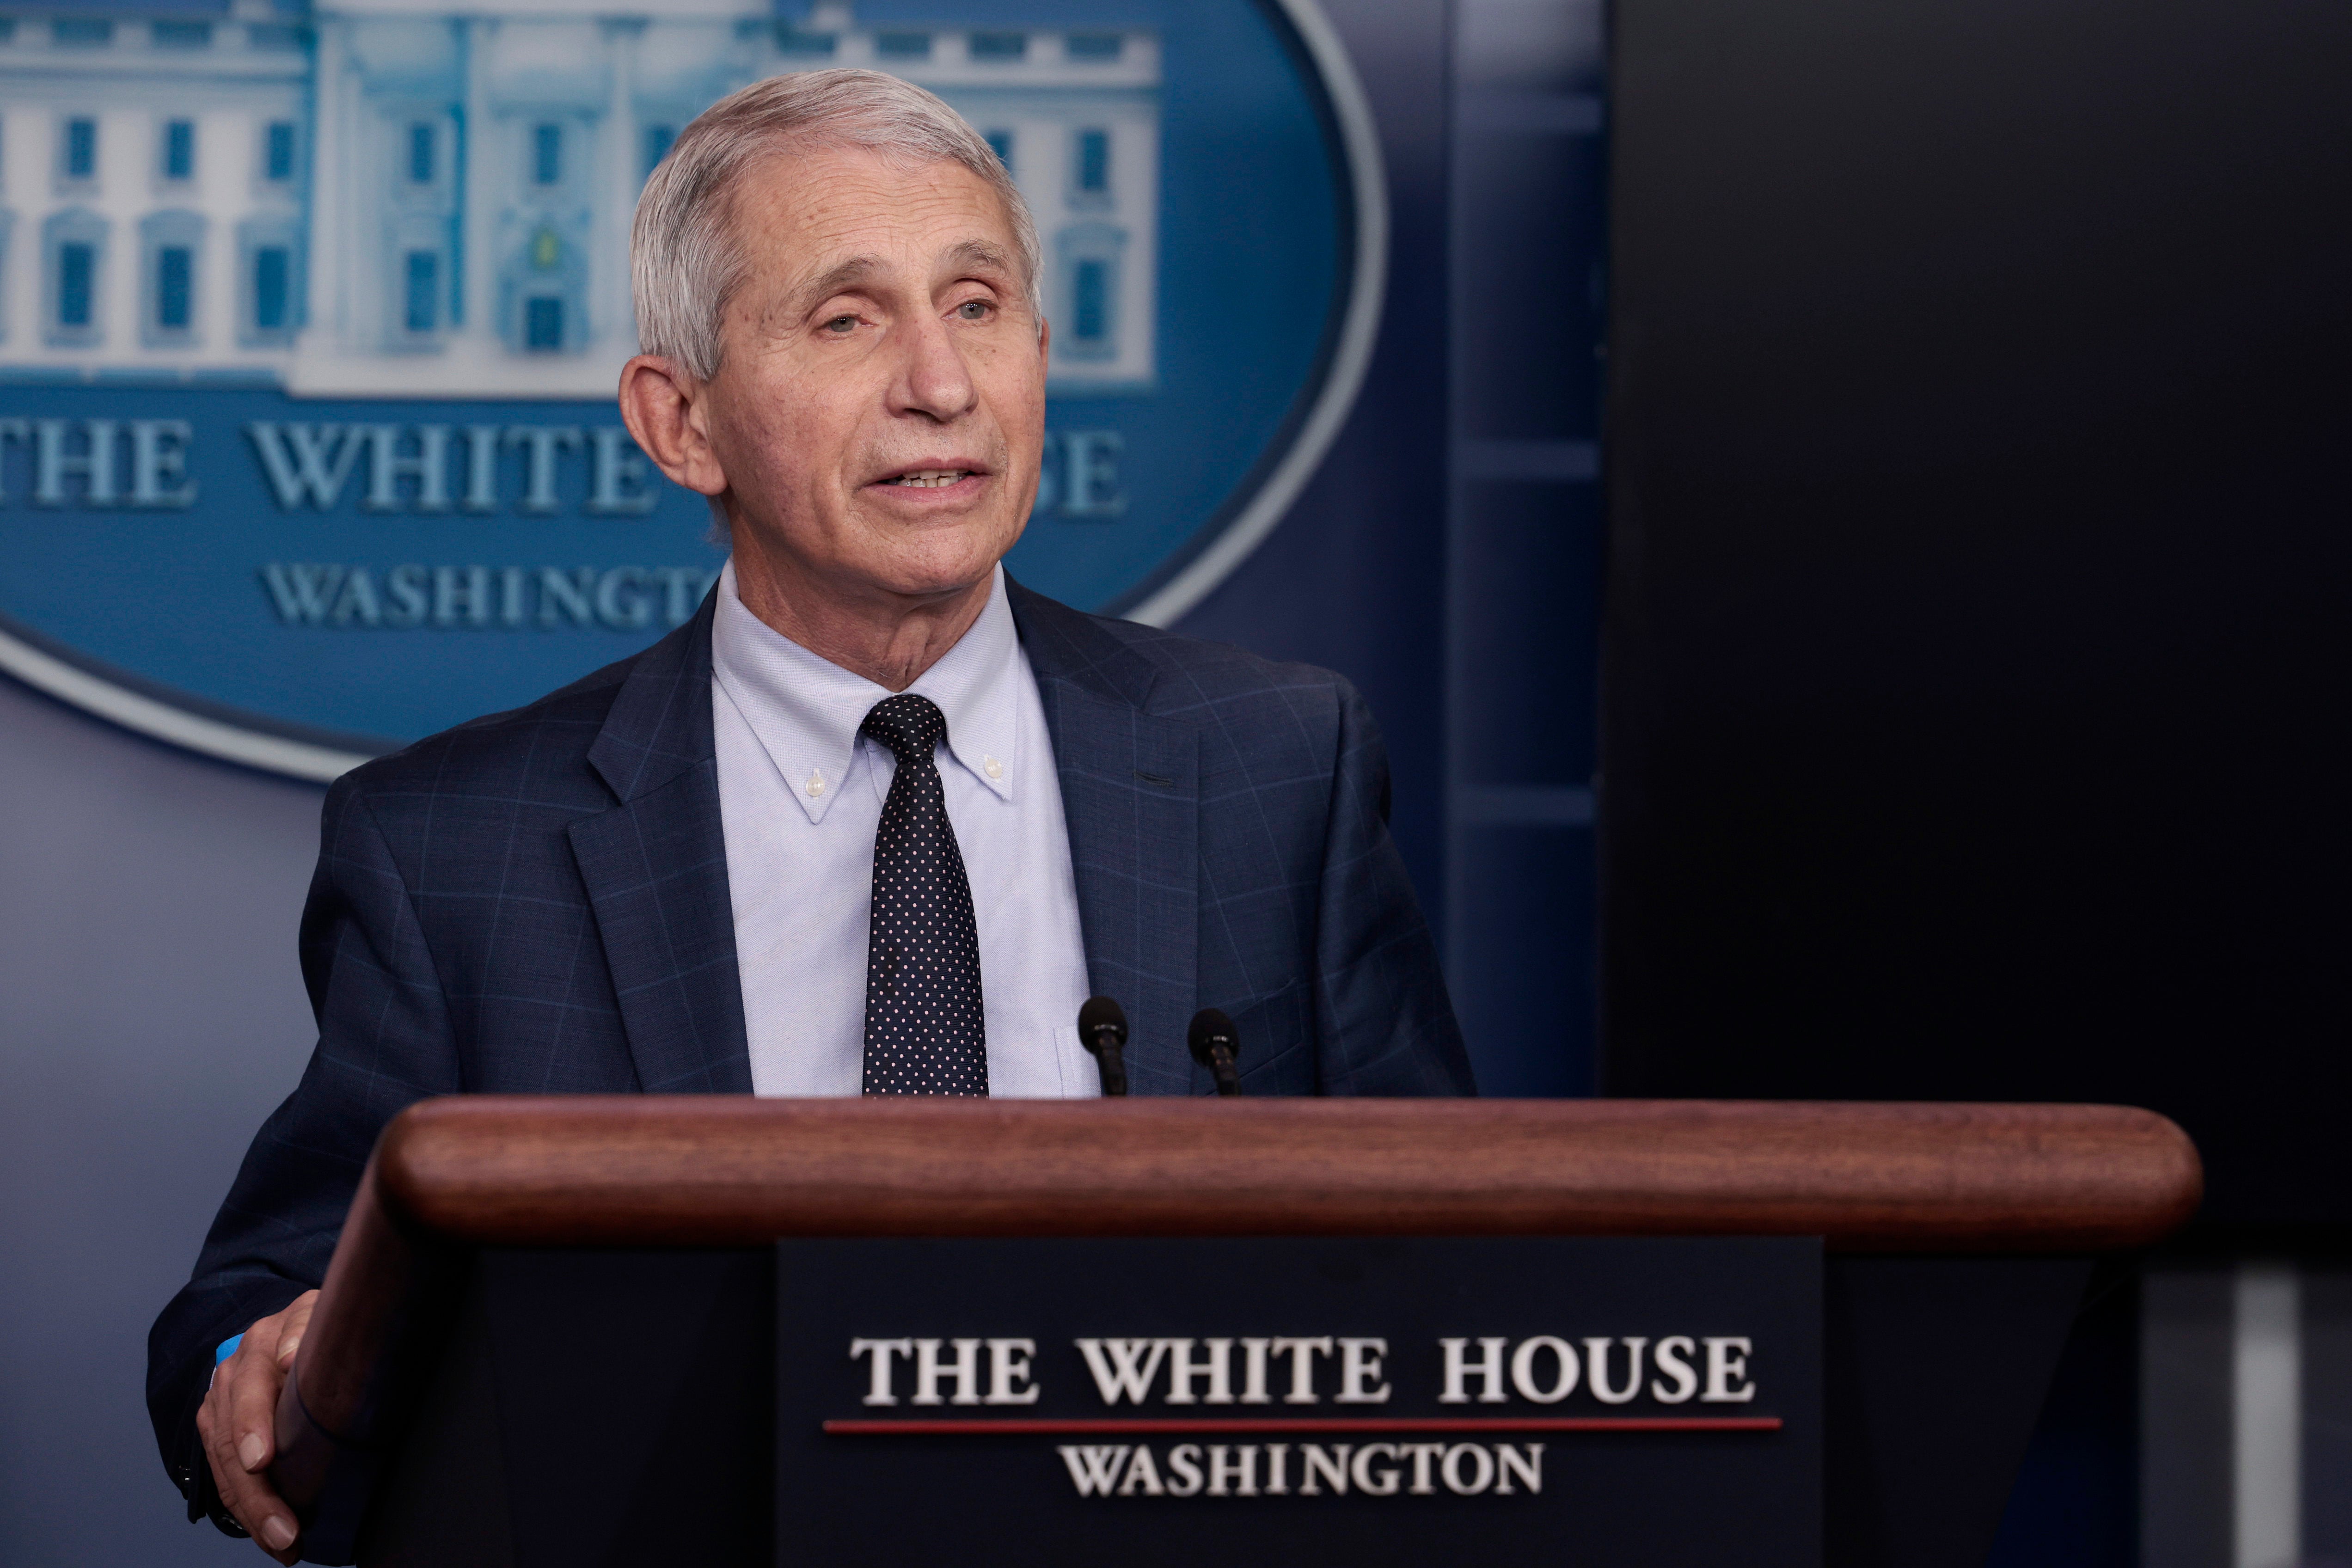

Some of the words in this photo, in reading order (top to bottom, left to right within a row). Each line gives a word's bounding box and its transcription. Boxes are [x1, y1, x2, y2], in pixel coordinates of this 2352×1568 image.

[250, 421, 659, 511] WHITE
[263, 563, 720, 627] WASHINGT
[851, 1338, 1039, 1404] THE
[1076, 1336, 1390, 1404] WHITE
[1439, 1335, 1754, 1403] HOUSE
[1059, 1443, 1542, 1496] WASHINGTON
